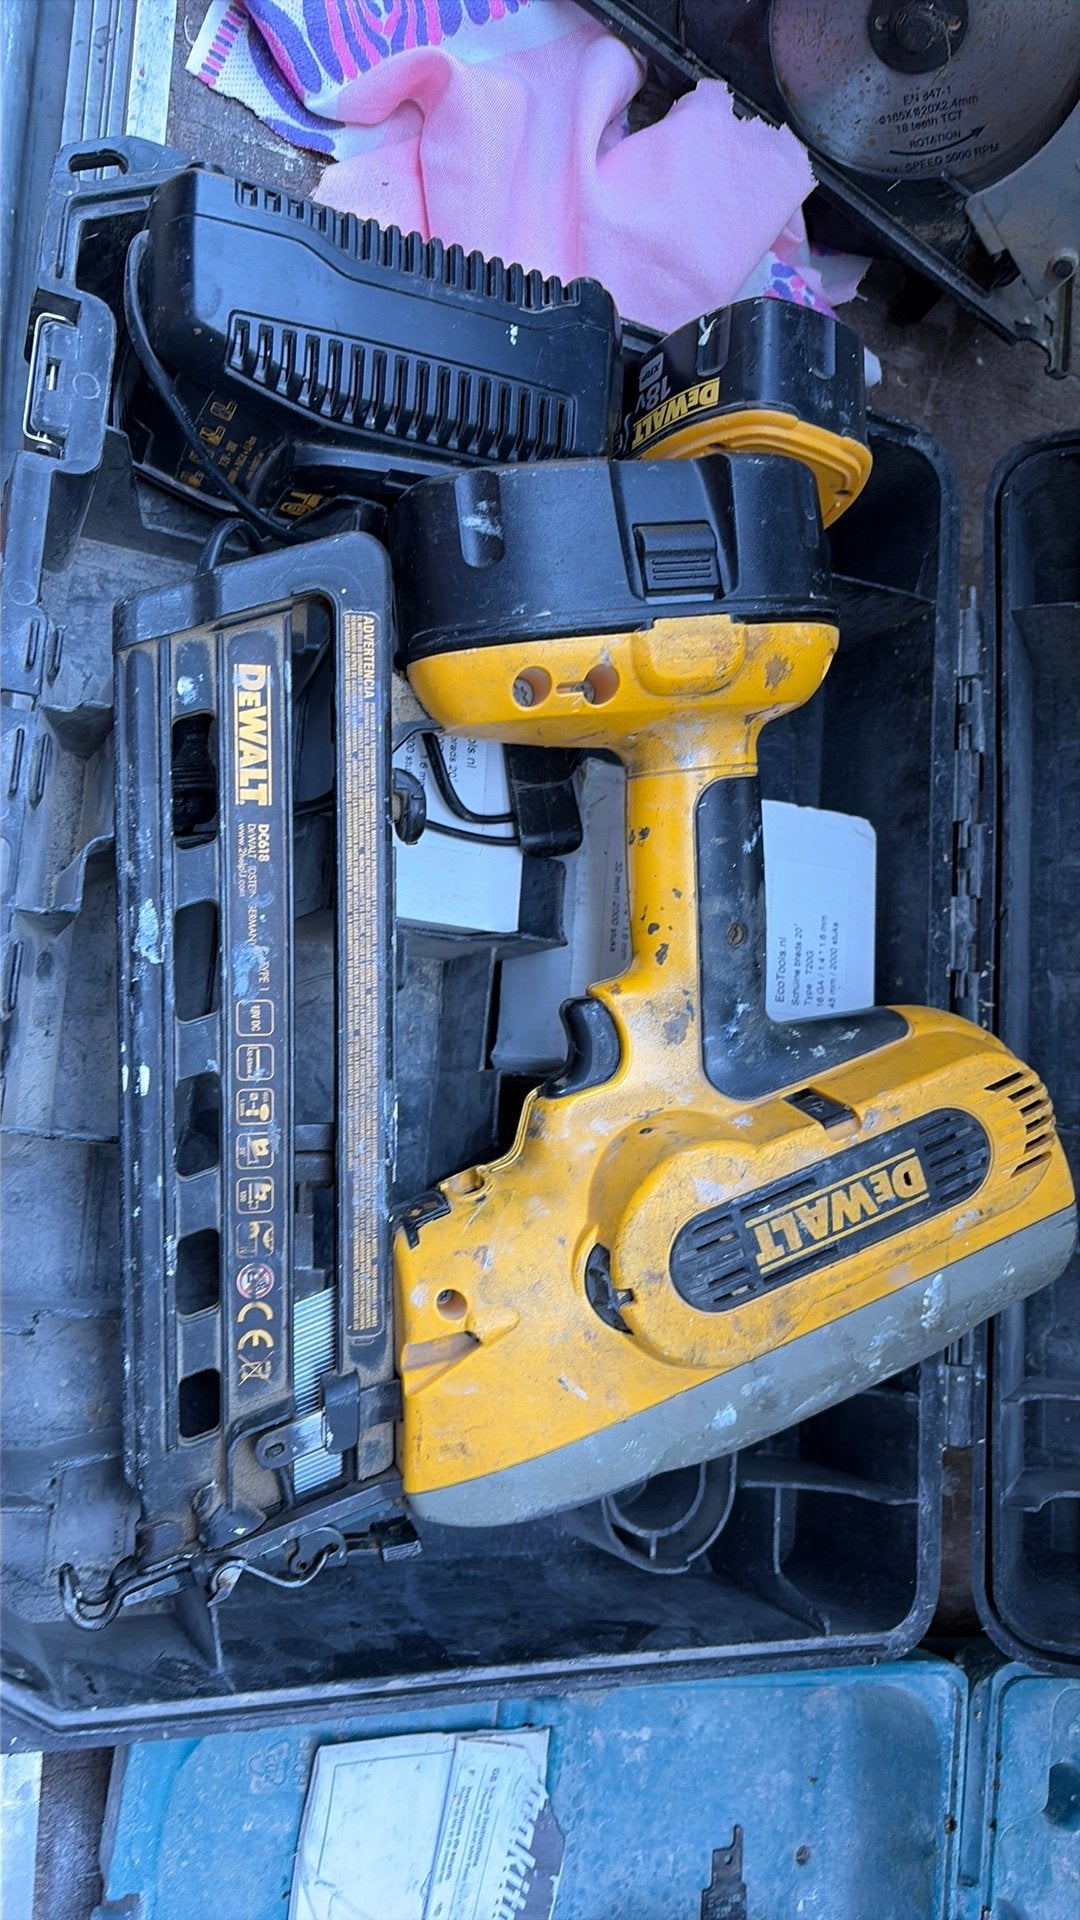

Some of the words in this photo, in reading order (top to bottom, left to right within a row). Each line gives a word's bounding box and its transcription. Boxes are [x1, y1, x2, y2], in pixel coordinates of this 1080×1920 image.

[909, 129, 961, 149] ROTATION
[941, 109, 964, 123] TCT
[904, 155, 943, 173] SPEED
[632, 380, 719, 449] DEWALT
[363, 615, 376, 699] ADVERTENCIA
[238, 663, 269, 806] DEWALT
[236, 822, 248, 898] www.2helpU.com
[258, 823, 271, 862] DC618
[753, 1155, 928, 1267] DEWALT
